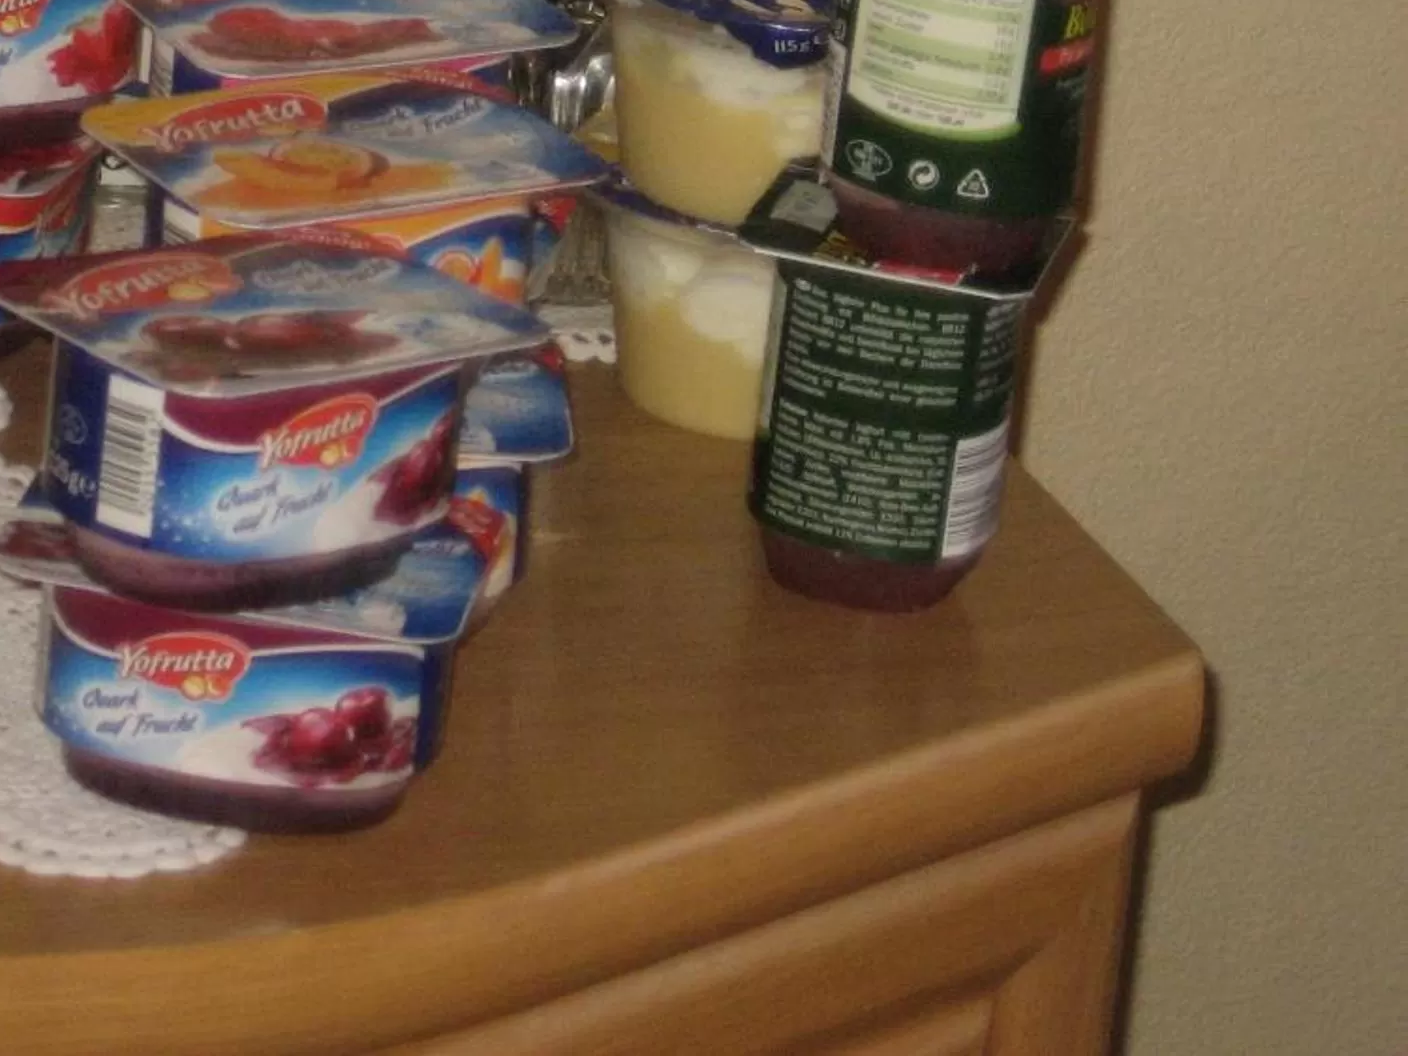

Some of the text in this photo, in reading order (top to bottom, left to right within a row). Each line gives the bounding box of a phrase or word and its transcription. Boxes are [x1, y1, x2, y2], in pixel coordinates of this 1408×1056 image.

[143, 98, 306, 153] Yofrutta
[261, 409, 366, 471] Yofrutta
[119, 643, 236, 679] Yofrutta
[82, 687, 139, 709] Quark
